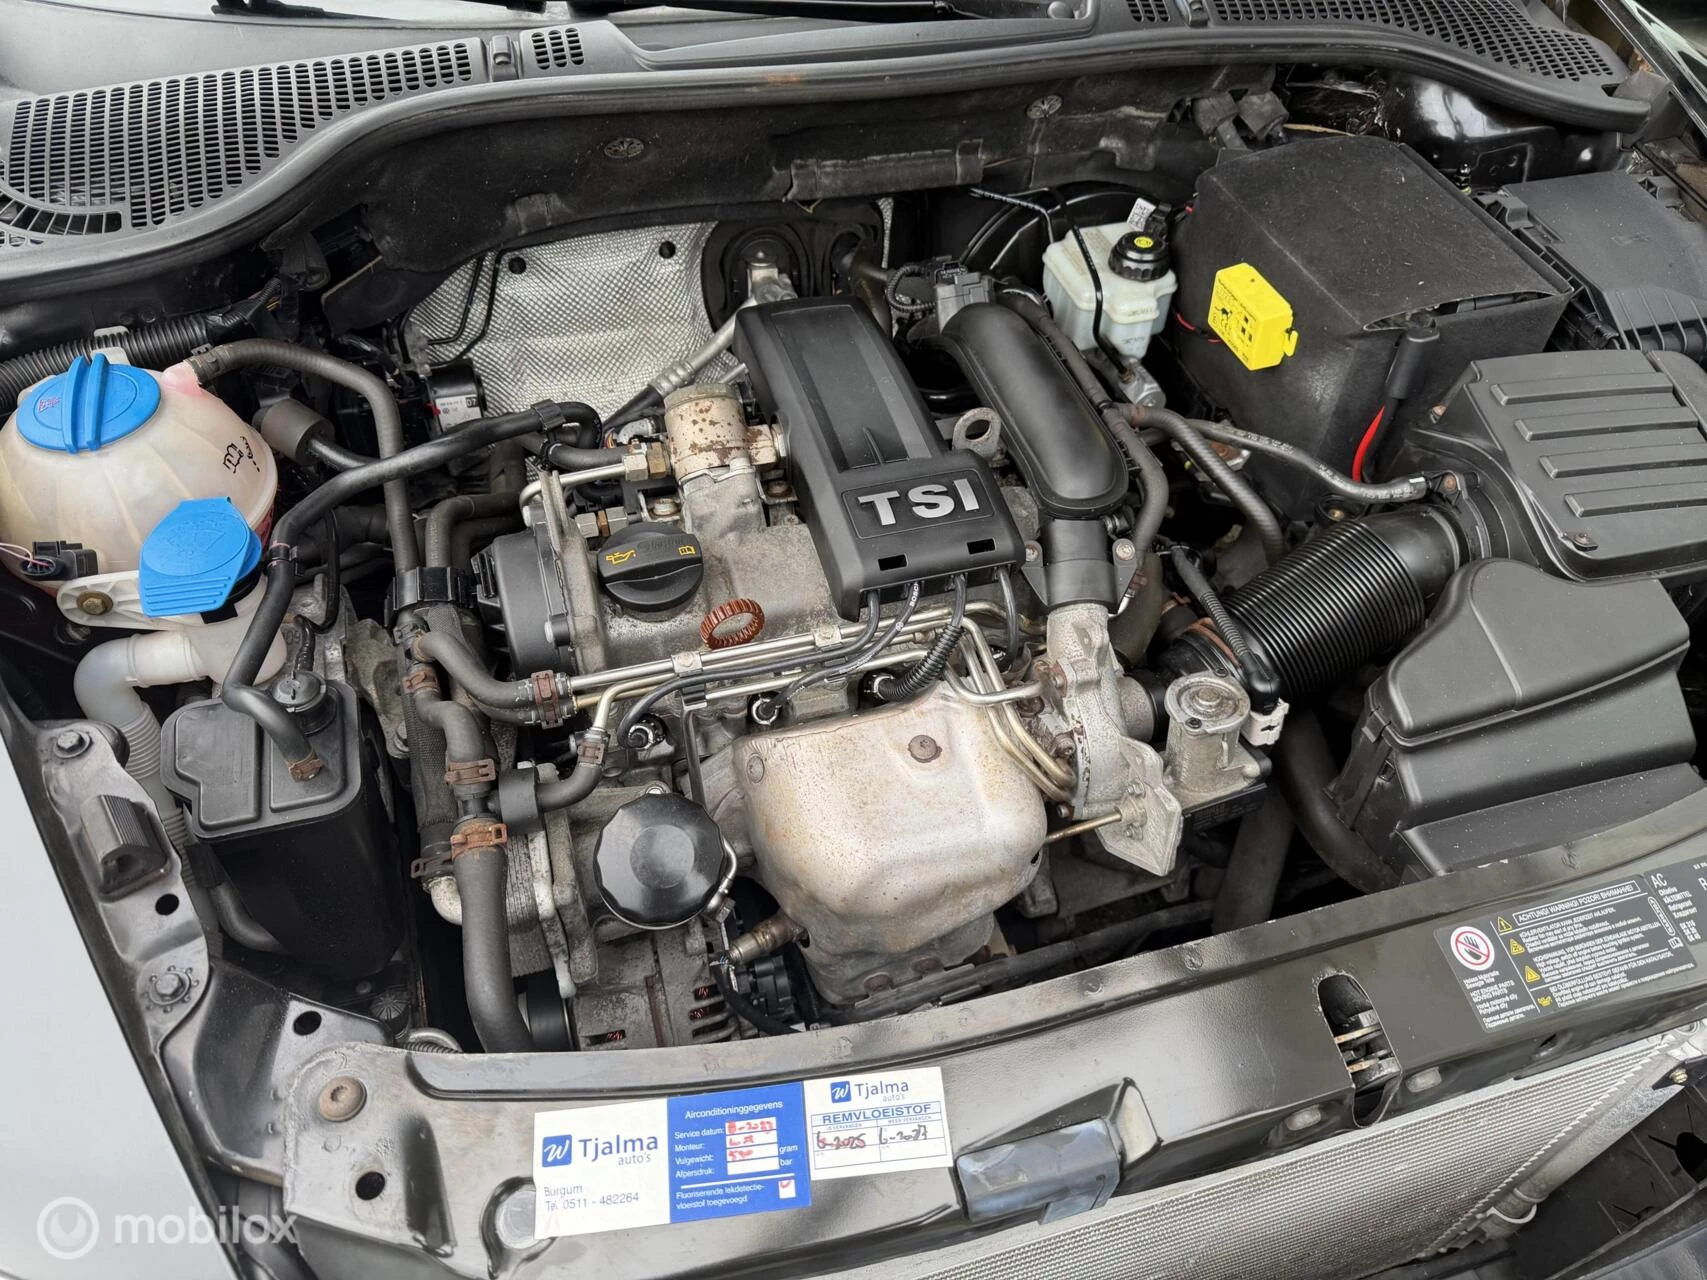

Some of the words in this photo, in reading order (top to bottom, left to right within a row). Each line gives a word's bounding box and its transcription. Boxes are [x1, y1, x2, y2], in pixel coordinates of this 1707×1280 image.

[857, 479, 980, 526] TSI
[1651, 873, 1667, 888] AC
[1517, 908, 1551, 922] ACHTUNG!
[1548, 899, 1580, 913] WARNING!
[855, 1081, 909, 1099] Tjalma
[882, 1093, 906, 1102] auto's
[685, 1101, 784, 1120] Airconditioninggegevens
[822, 1103, 931, 1125] REMVLOEISTOF
[674, 1129, 700, 1140] Service
[701, 1127, 724, 1136] datum:
[578, 1134, 658, 1162] Tjalma
[674, 1143, 705, 1152] Monteur:
[779, 1144, 798, 1155] gram
[618, 1152, 652, 1166] auto's
[675, 1154, 714, 1166] Vulgewicht:
[780, 1159, 792, 1167] bar
[544, 1185, 583, 1199] Burgum
[676, 1186, 724, 1200] Fluoriserende
[563, 1198, 587, 1210] 0511
[599, 1192, 640, 1205] 482264
